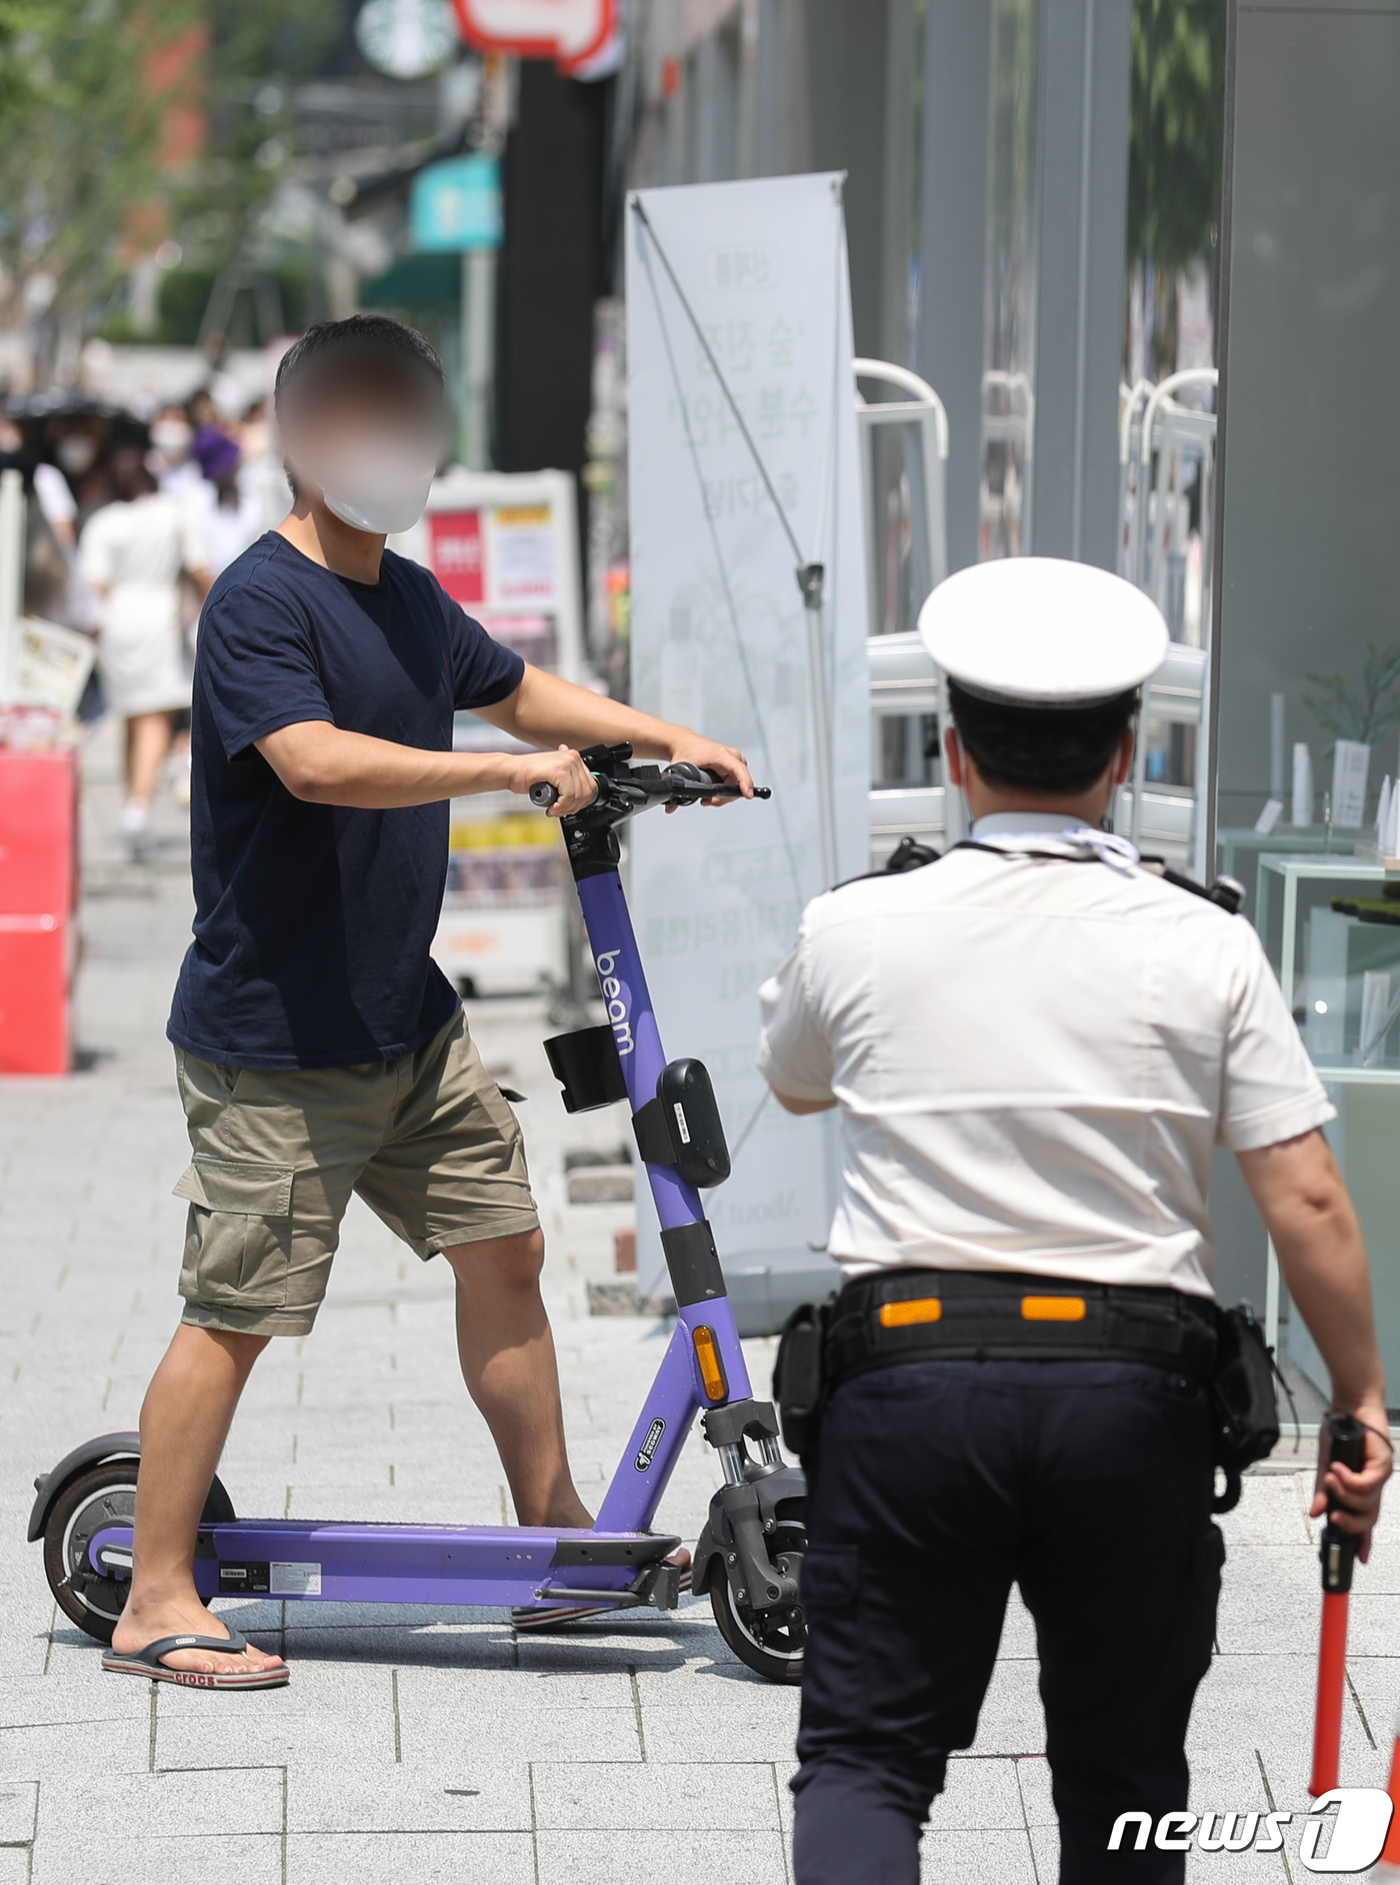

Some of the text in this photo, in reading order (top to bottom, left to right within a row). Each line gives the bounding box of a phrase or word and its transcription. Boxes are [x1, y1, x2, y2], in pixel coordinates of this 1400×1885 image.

[597, 949, 635, 1057] beam
[646, 1424, 662, 1455] SEGWAY
[175, 1672, 215, 1687] crocs
